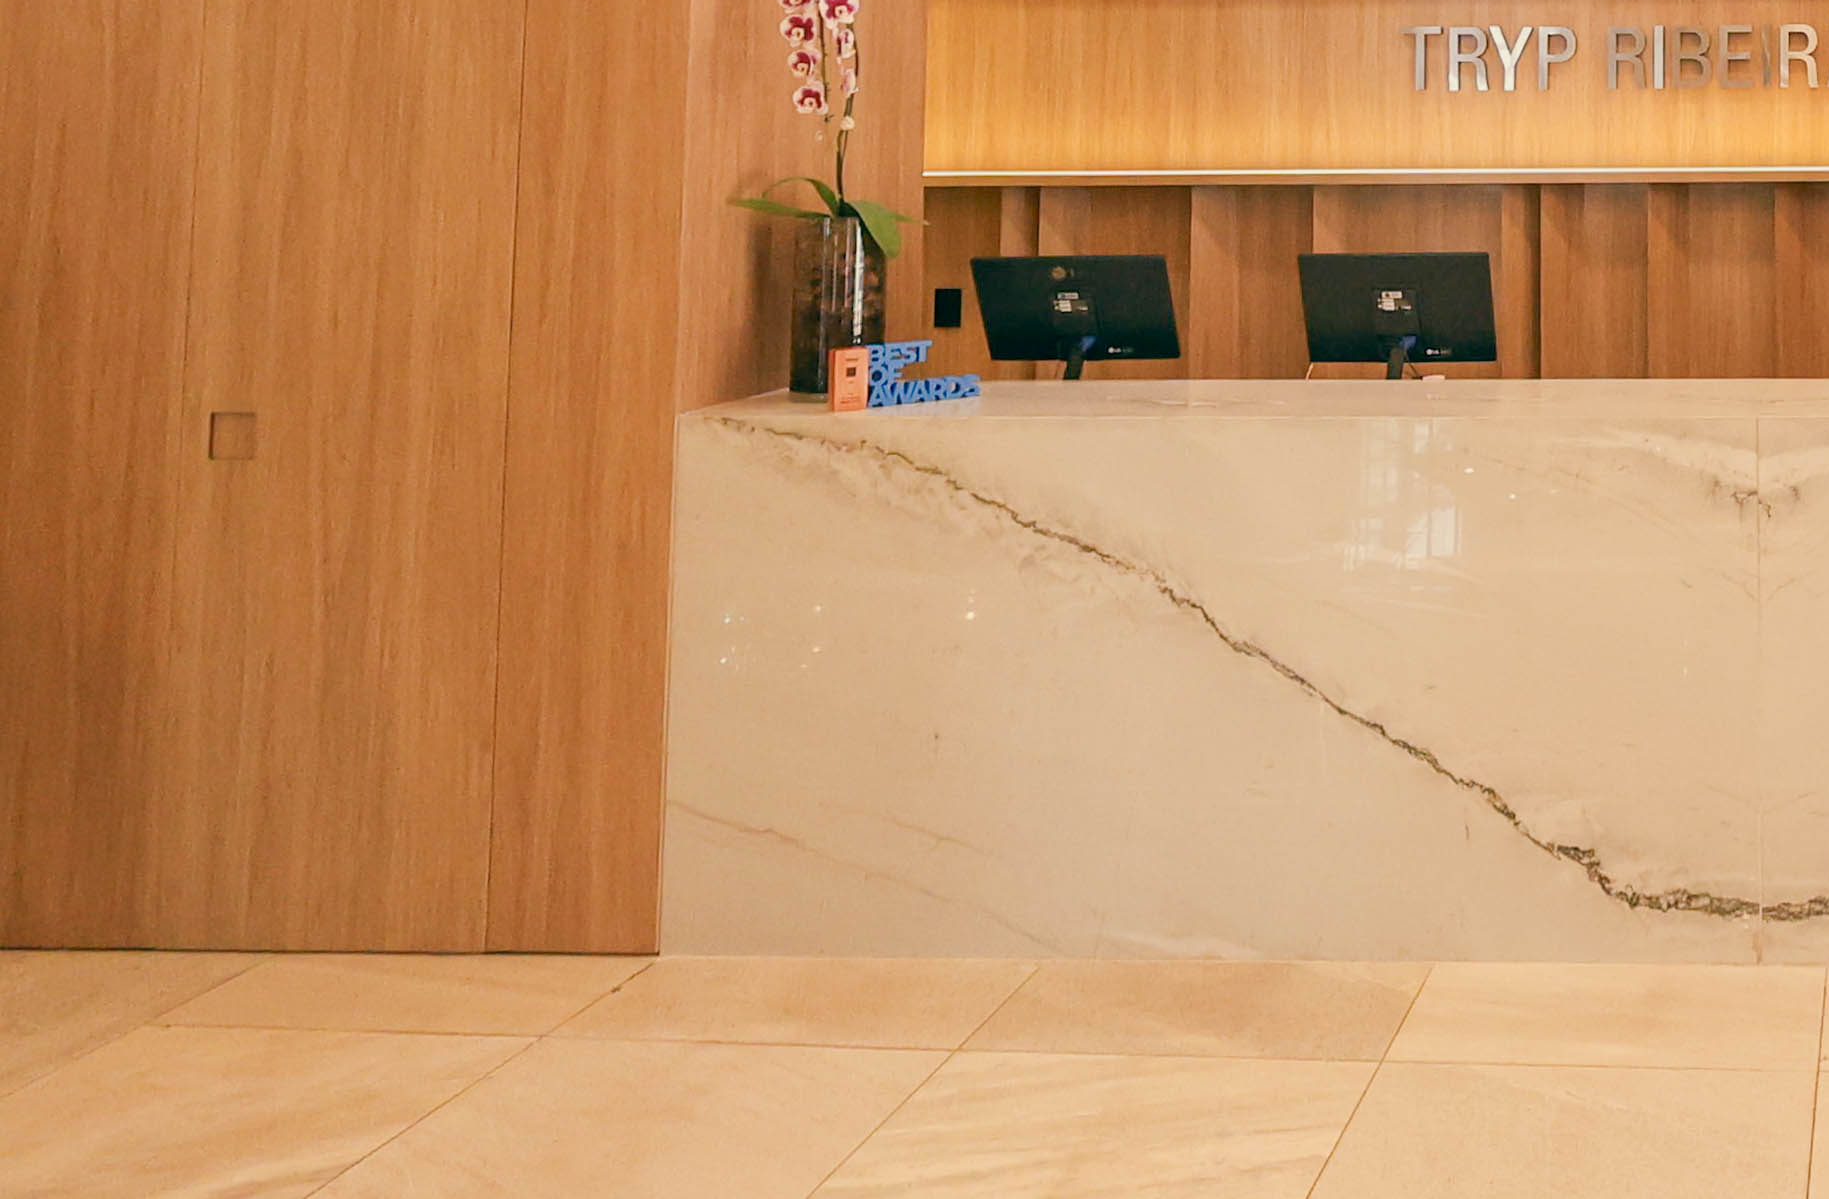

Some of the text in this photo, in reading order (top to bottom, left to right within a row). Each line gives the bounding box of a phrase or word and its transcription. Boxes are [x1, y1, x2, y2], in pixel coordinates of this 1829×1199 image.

[1401, 24, 1578, 92] TRYP
[867, 340, 933, 365] BEST
[868, 374, 981, 408] AWARDS
